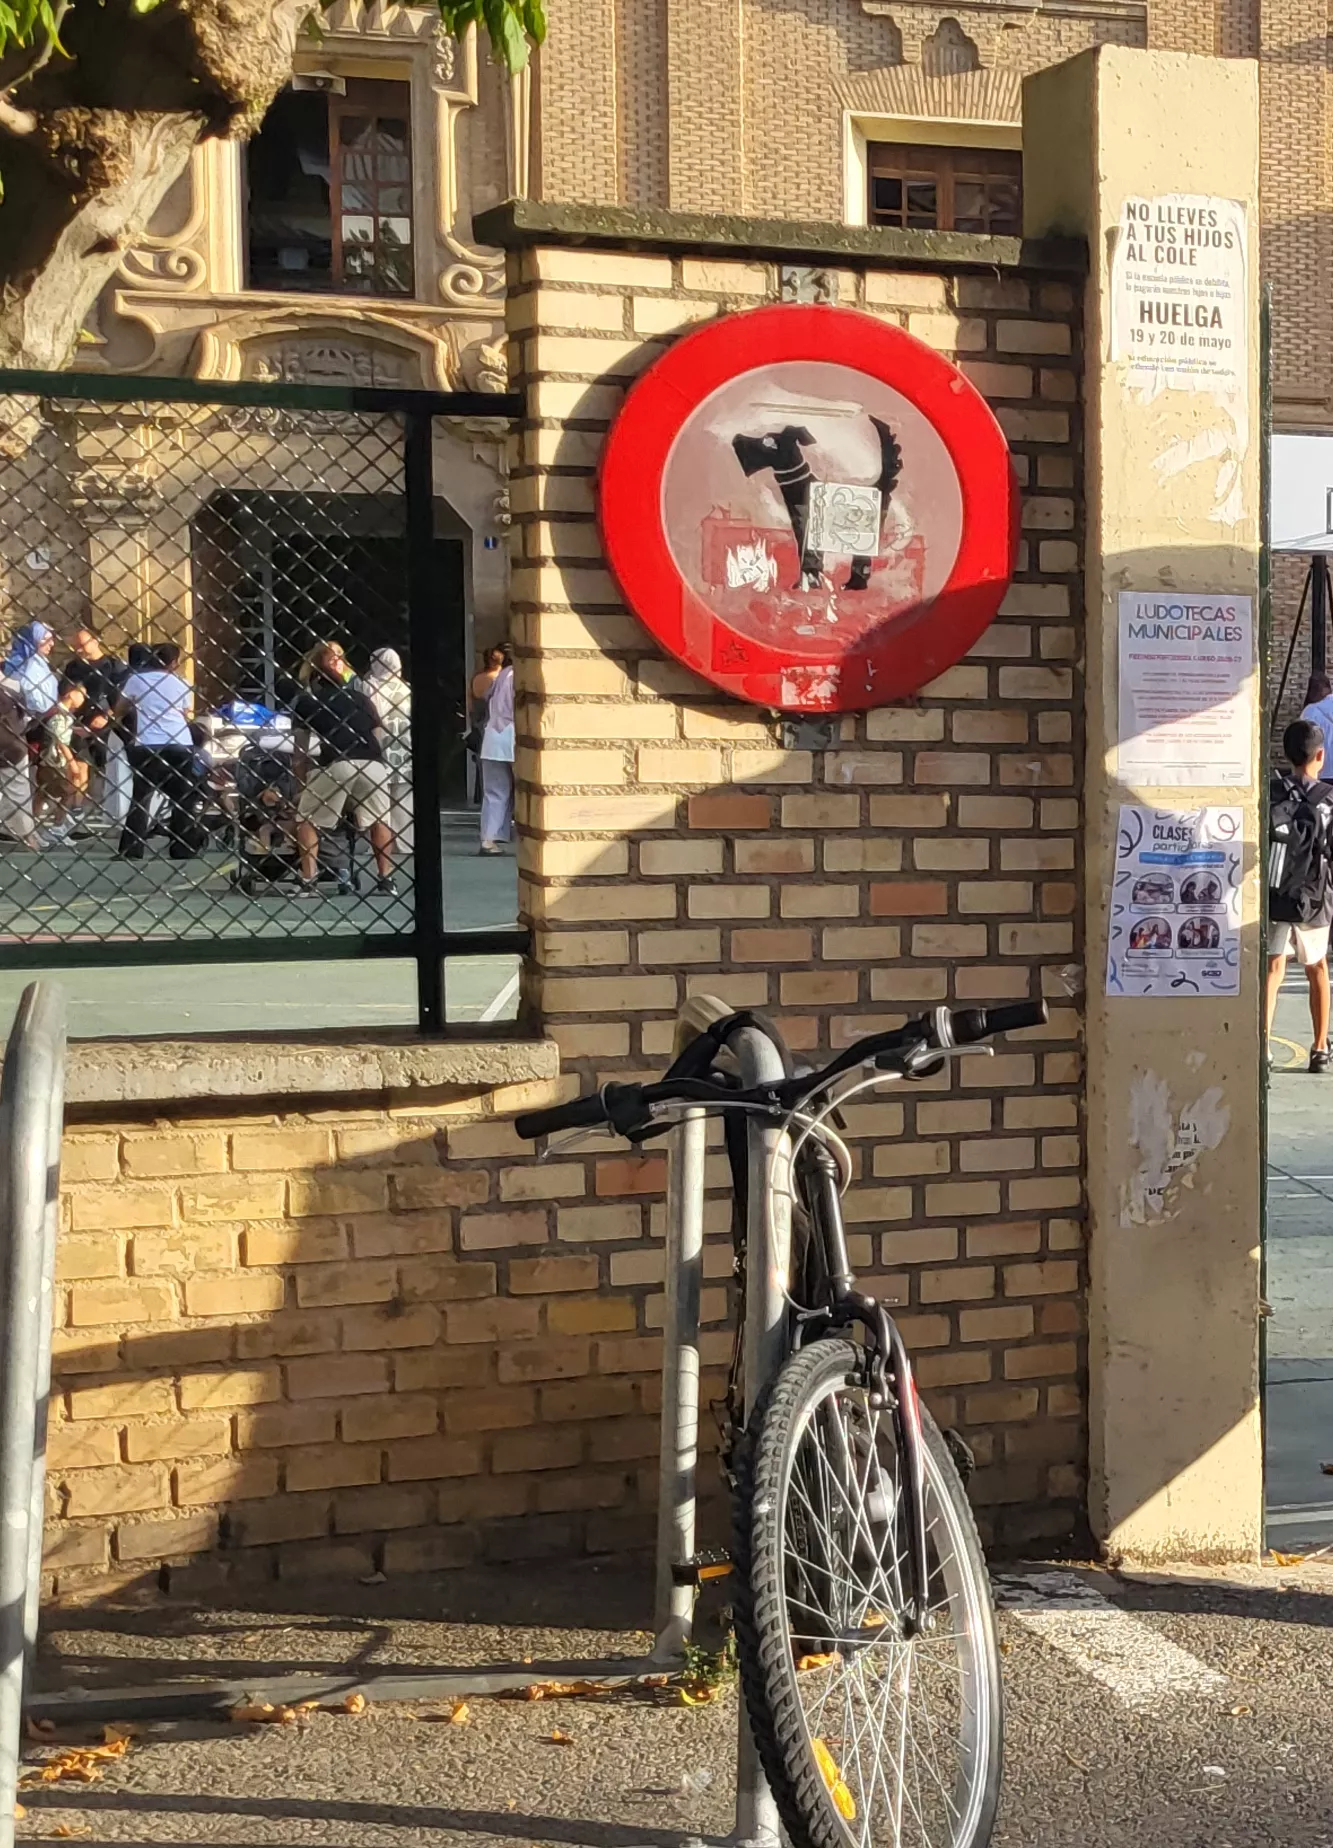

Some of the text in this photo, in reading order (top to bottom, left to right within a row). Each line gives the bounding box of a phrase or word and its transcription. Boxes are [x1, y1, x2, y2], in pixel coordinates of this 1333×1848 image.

[1126, 202, 1218, 228] NO LLEVES
[1126, 222, 1234, 250] A TUS HIJOS
[1126, 242, 1198, 267] AL COLE
[1139, 300, 1223, 329] HUELGA
[1130, 328, 1232, 351] 19 y 20 de mayo
[1136, 604, 1236, 622] LUDOTECAS
[1128, 623, 1243, 641] MUNICIPALES
